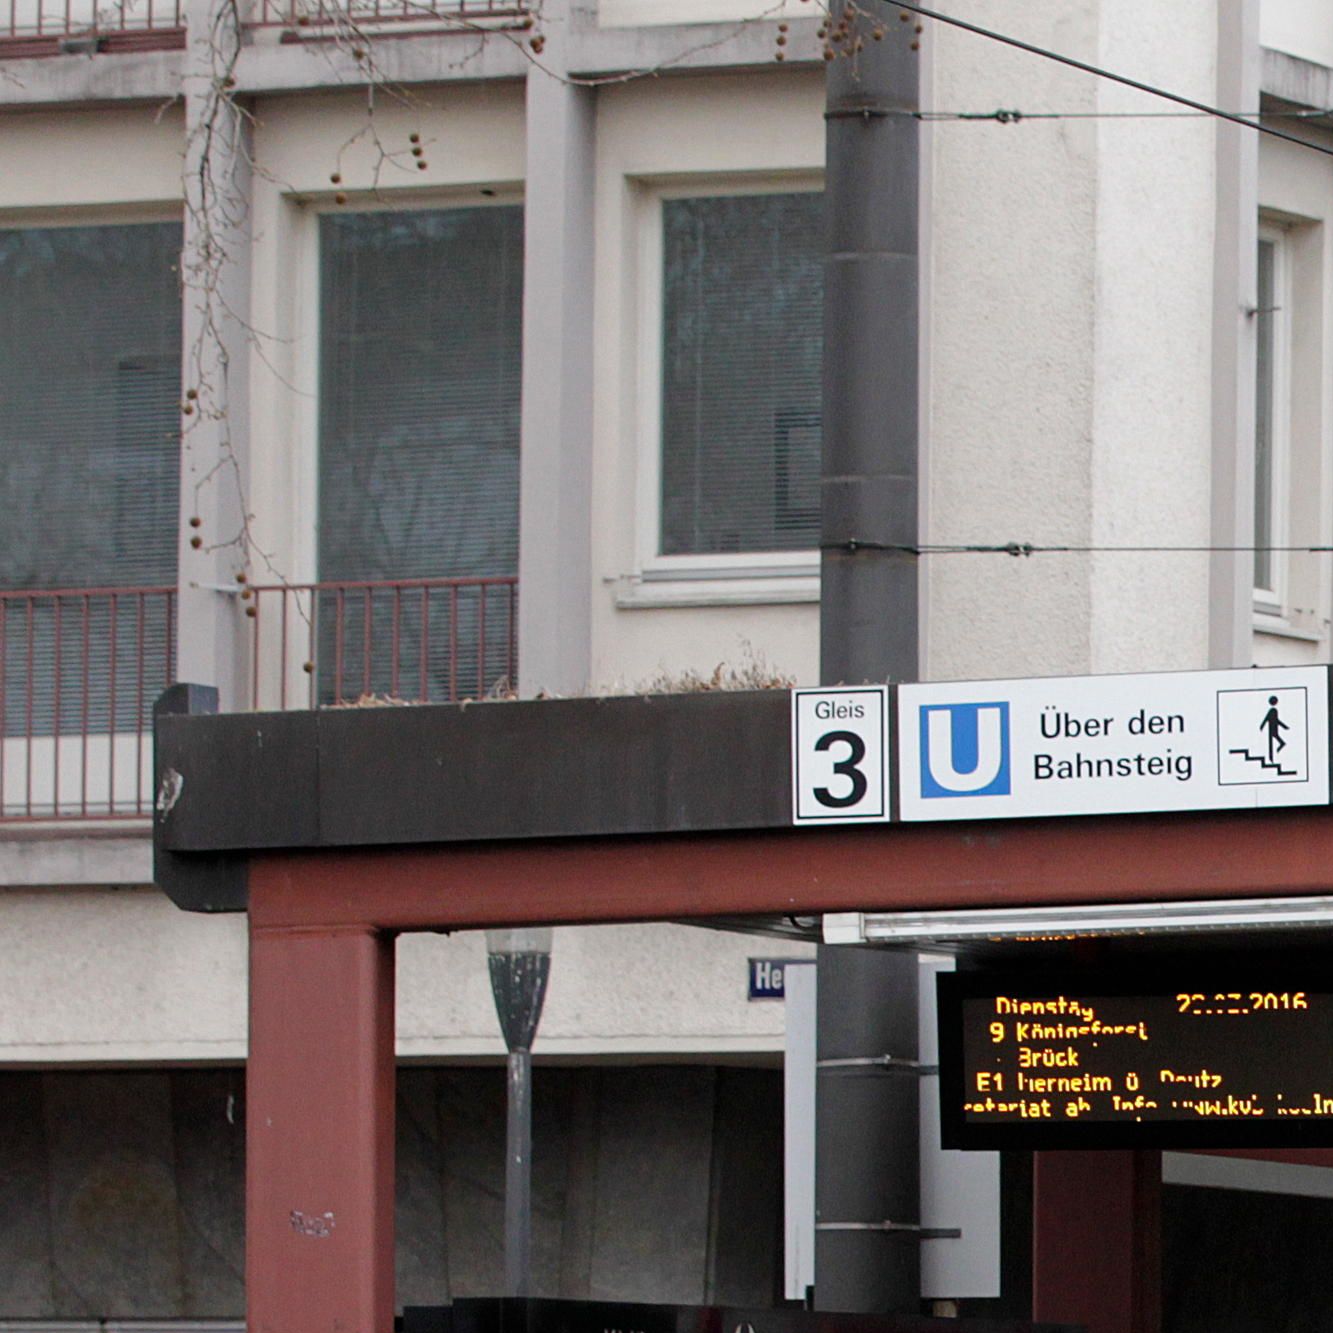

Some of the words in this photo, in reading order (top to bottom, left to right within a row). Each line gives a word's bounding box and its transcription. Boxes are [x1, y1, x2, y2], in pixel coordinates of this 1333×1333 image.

[814, 700, 865, 721] Gleis
[1039, 705, 1115, 739] Über
[1127, 708, 1185, 736] den
[927, 706, 1002, 792] U
[812, 729, 868, 808] 3
[1033, 751, 1194, 781] Bahnsteig
[989, 1021, 1005, 1042] 9
[976, 1071, 1003, 1092] E1
